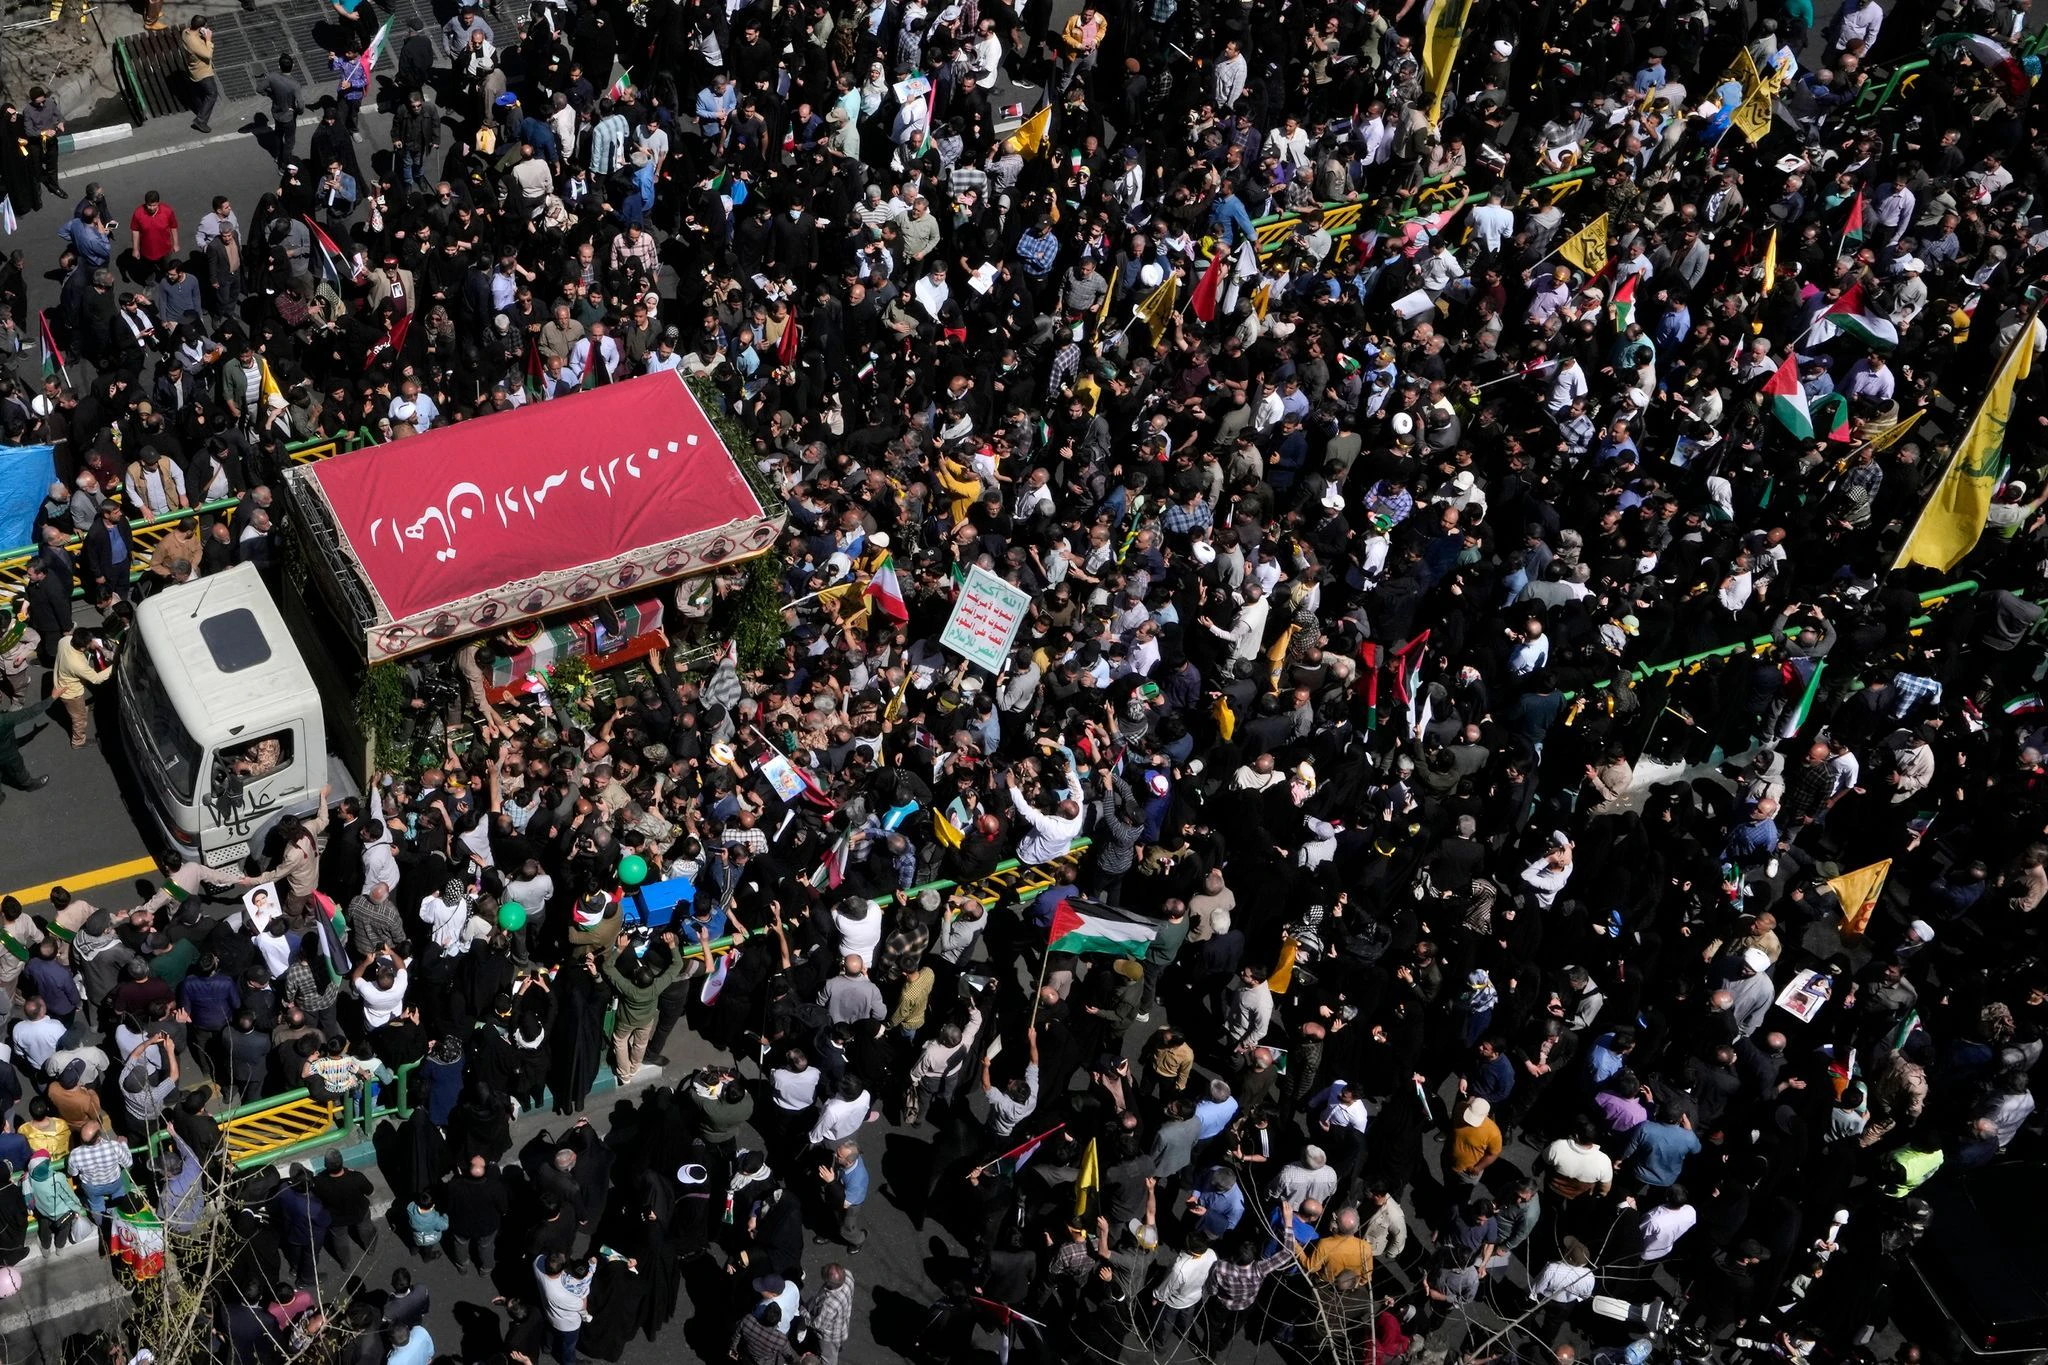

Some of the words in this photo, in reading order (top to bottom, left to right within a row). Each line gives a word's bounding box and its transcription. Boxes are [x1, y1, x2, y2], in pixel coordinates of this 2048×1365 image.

[370, 482, 485, 562] راهتان
[496, 469, 568, 528] ادامه
[1001, 596, 1021, 610] الله
[993, 607, 1016, 622] الموت
[956, 617, 976, 631] اليهود
[988, 619, 1011, 635] الموت
[974, 646, 1000, 661] النصر
